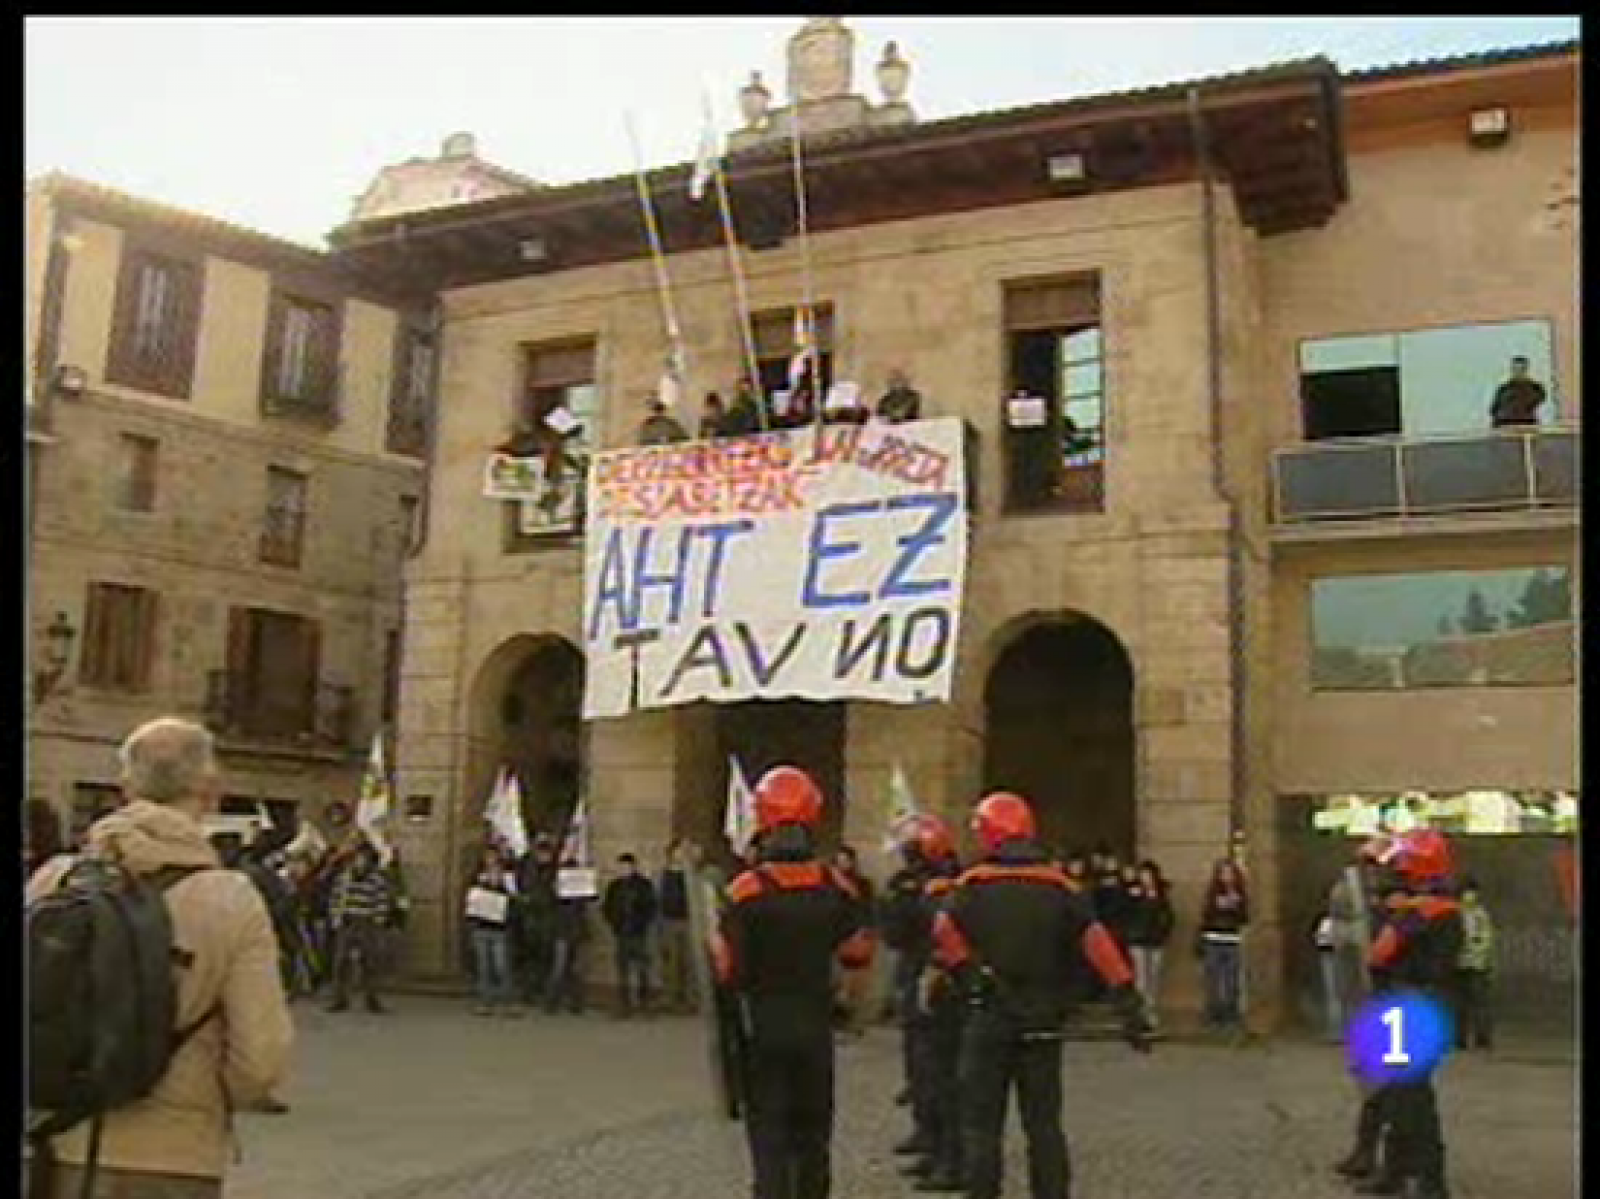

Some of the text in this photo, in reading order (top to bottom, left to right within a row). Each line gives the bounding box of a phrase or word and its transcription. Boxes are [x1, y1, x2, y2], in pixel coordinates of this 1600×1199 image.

[590, 493, 958, 640] AHT EZ
[613, 607, 949, 698] TAV NO
